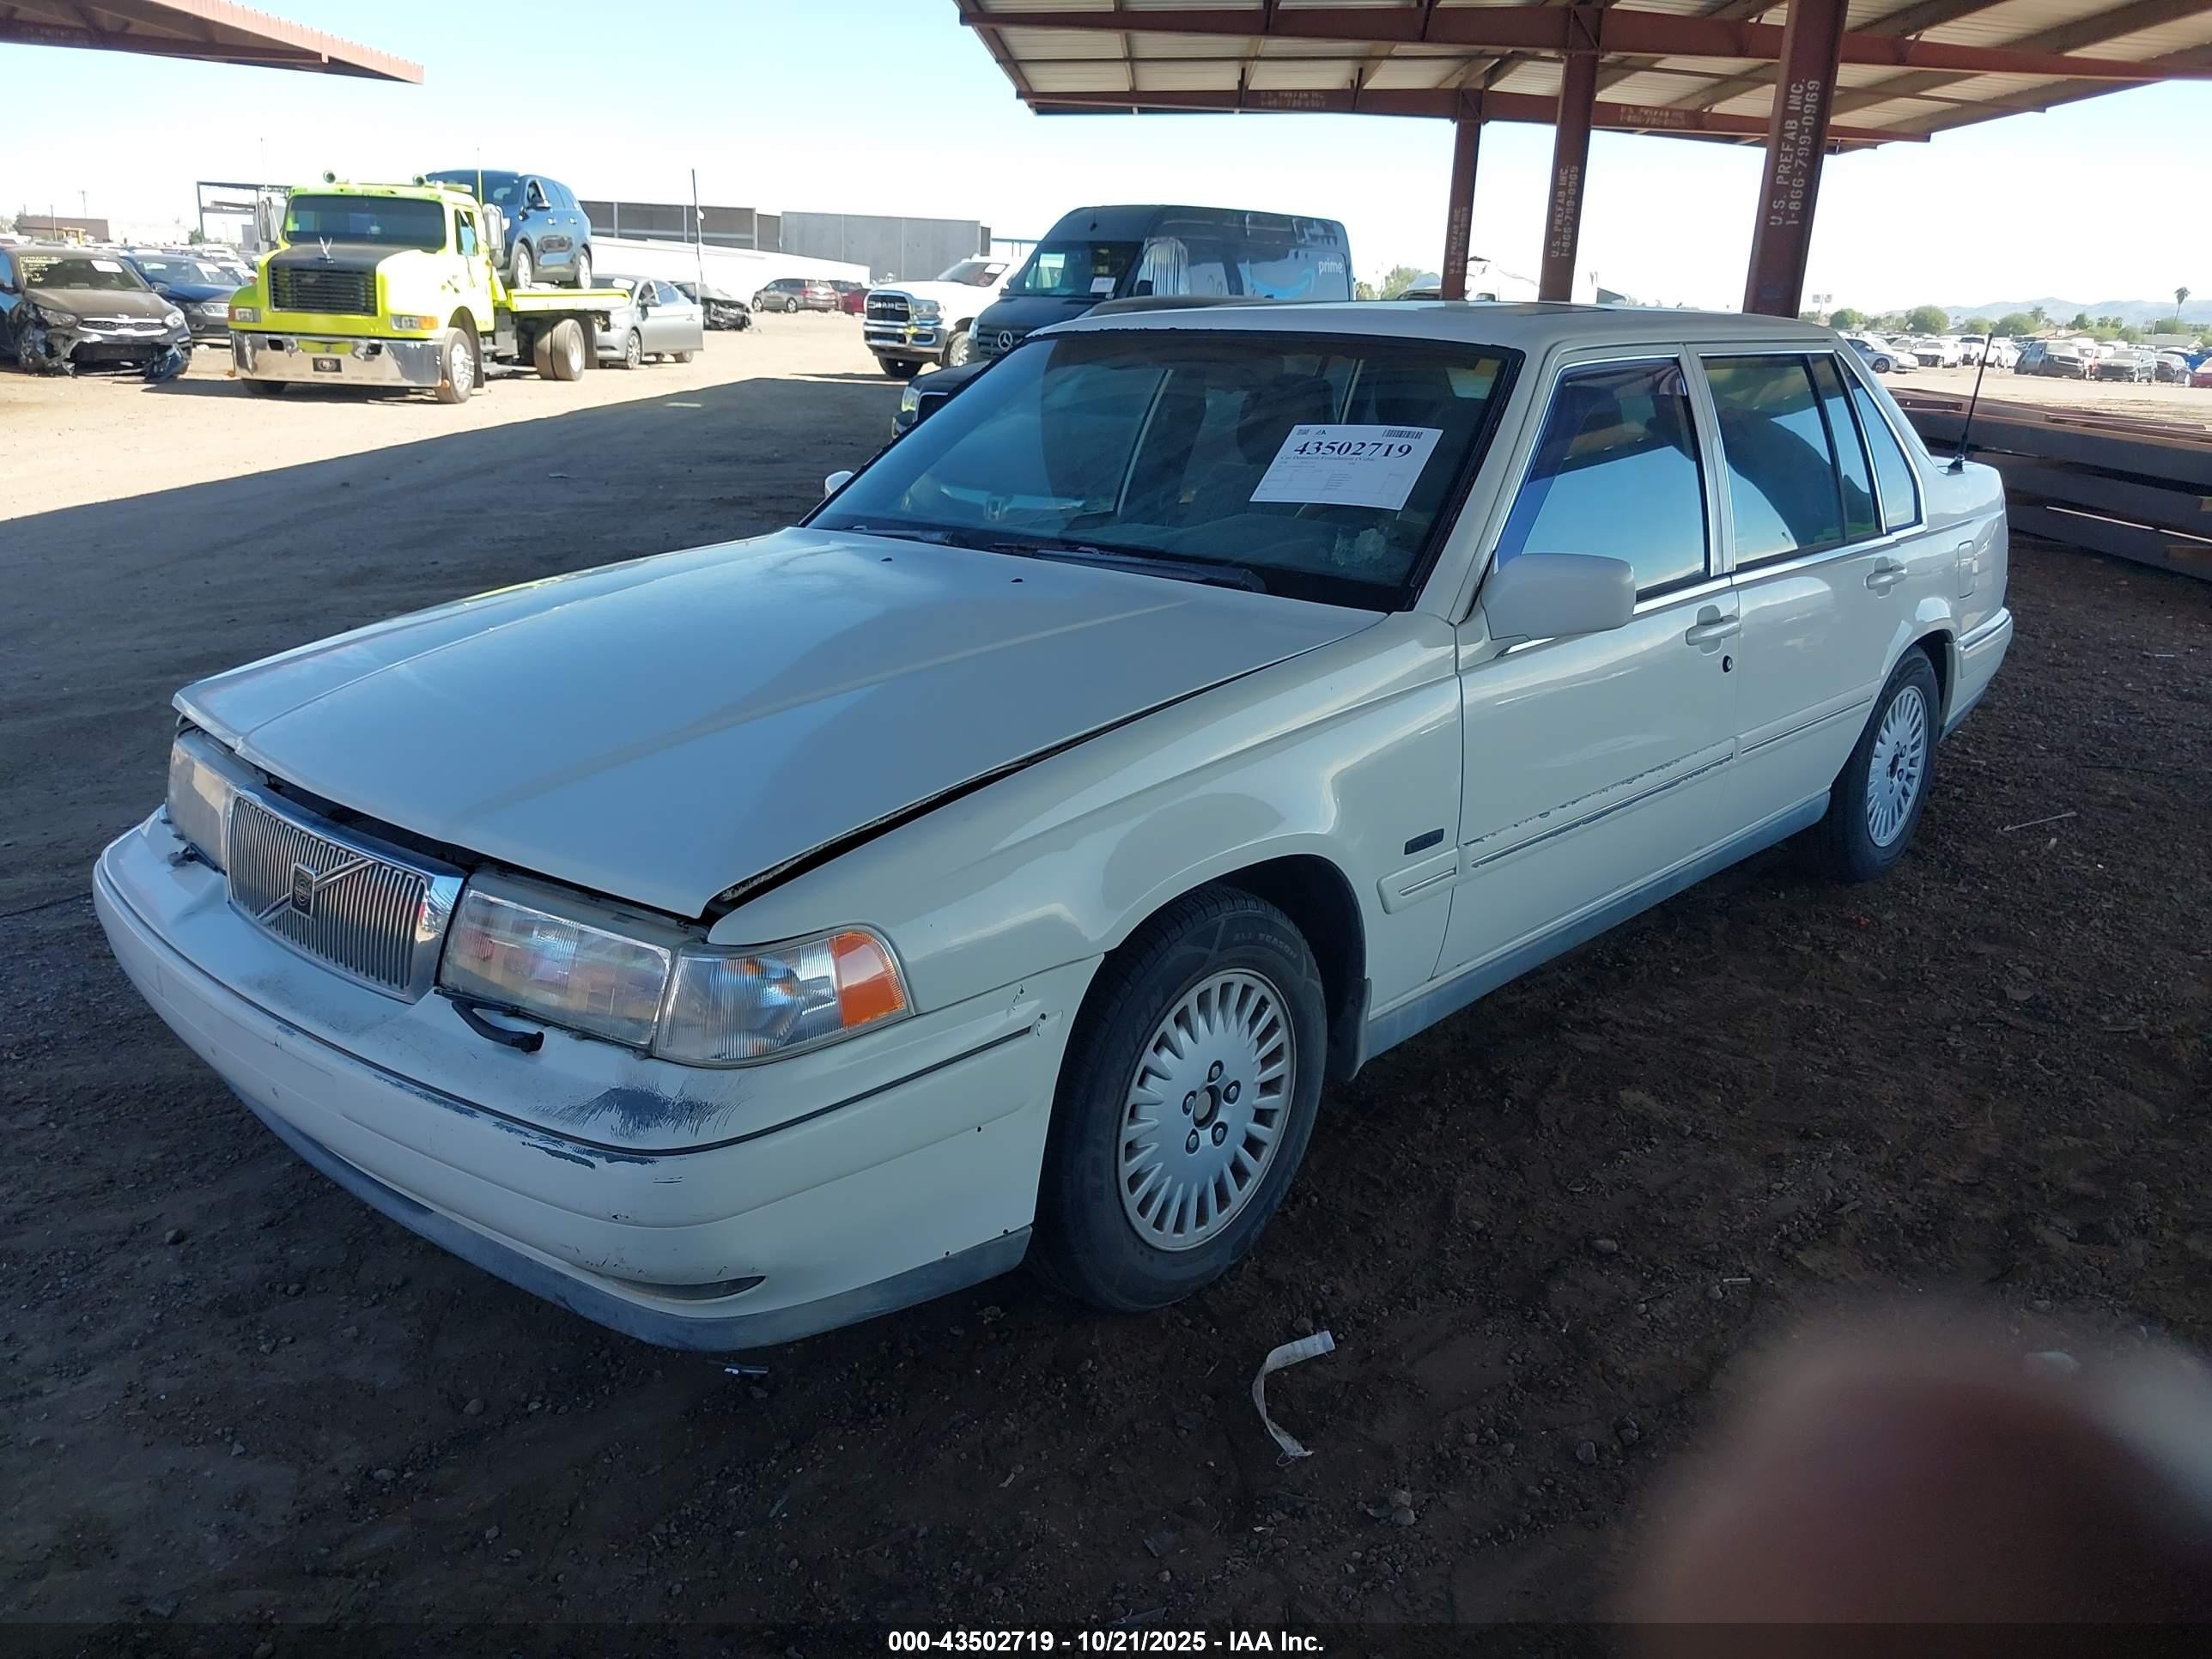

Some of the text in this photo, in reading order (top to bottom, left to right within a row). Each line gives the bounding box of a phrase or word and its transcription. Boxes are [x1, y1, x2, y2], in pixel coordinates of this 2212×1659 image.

[1770, 79, 1805, 226] U.S. PREFAB INC.
[1318, 258, 1343, 275] prime
[1293, 441, 1413, 459] 43502719
